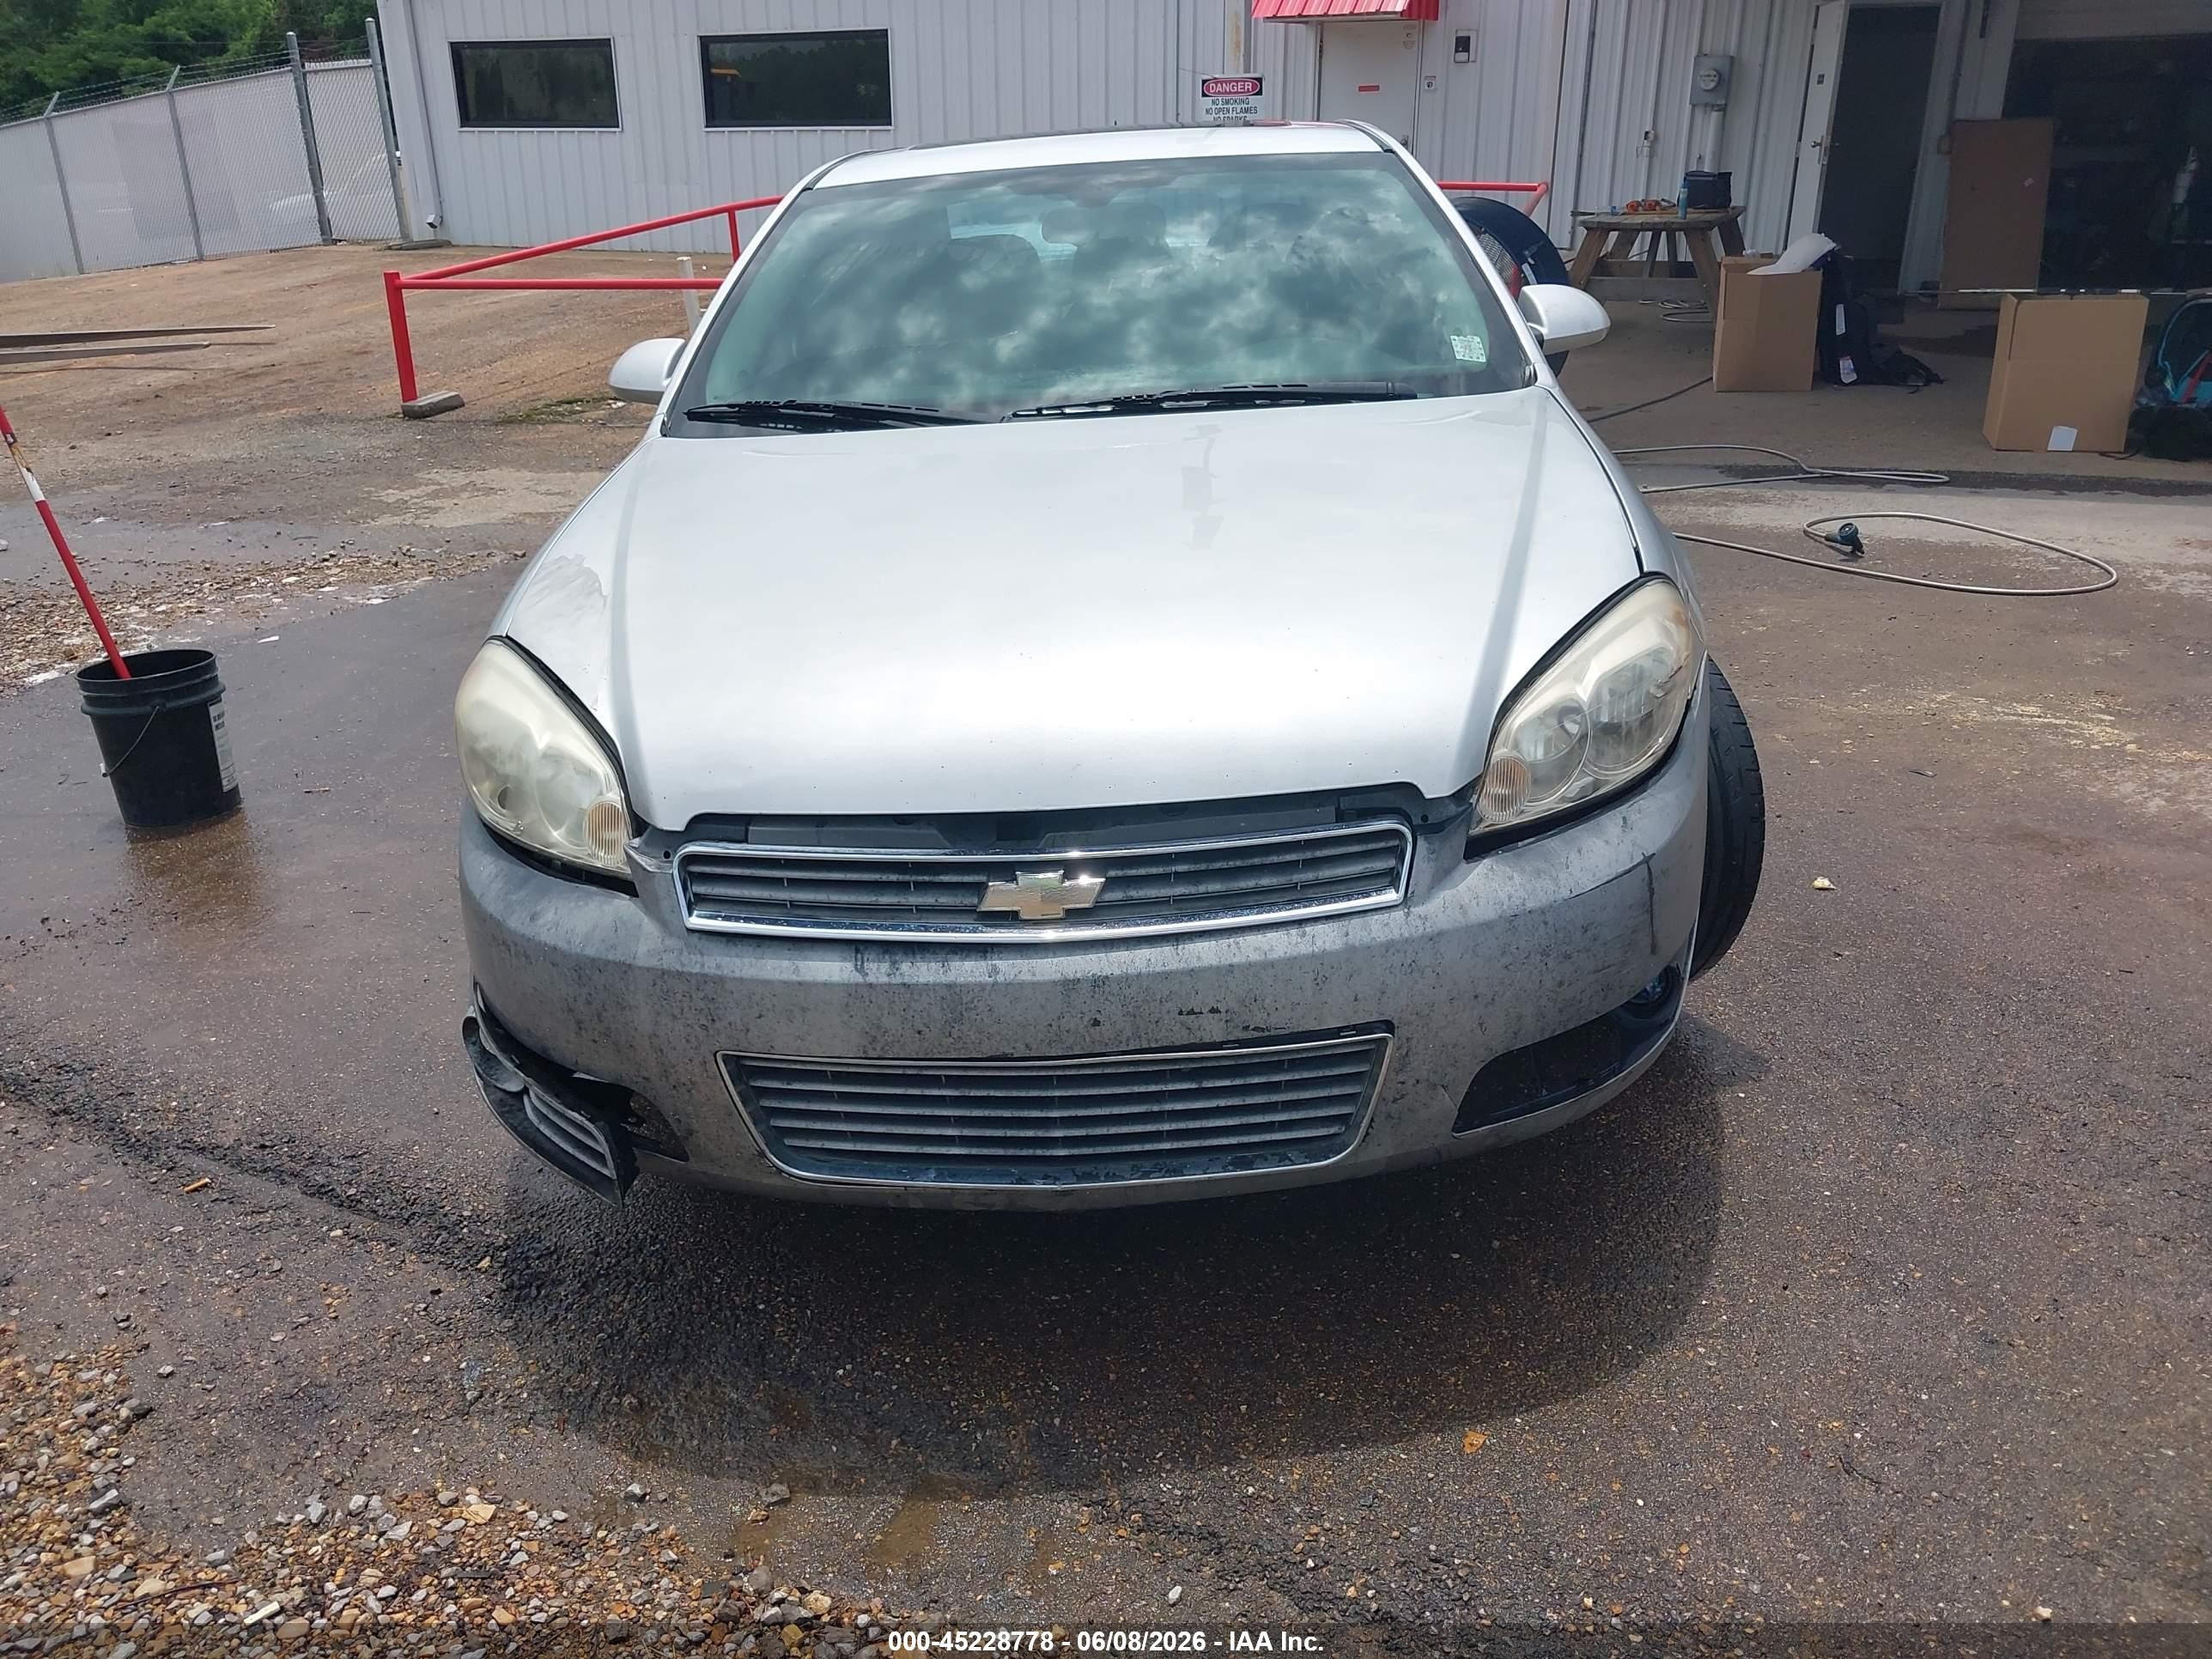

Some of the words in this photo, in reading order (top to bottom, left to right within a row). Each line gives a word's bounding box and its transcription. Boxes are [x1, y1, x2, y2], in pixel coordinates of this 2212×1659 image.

[1209, 82, 1252, 93] DANGER
[1212, 98, 1220, 106] NO
[1221, 97, 1250, 106] SMOKING
[1205, 107, 1213, 116] NO
[1214, 106, 1231, 115] OPEN
[1231, 106, 1258, 114] FLAMES
